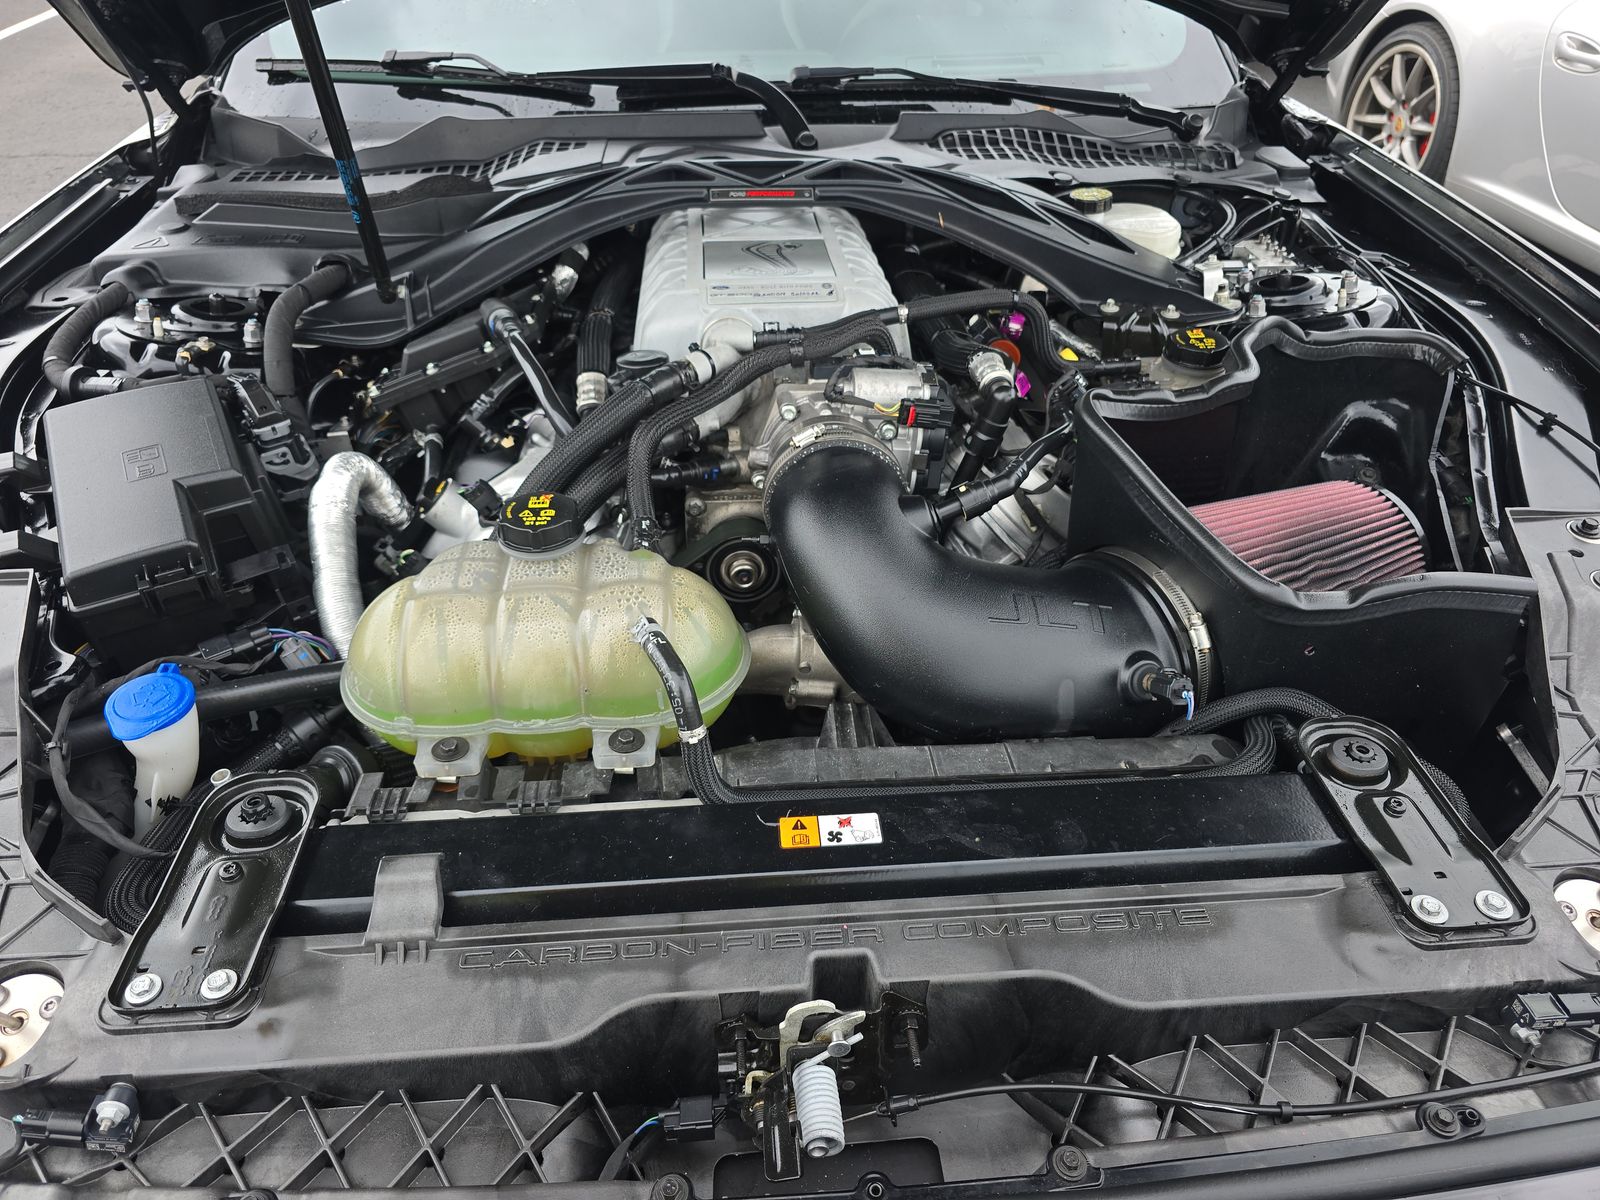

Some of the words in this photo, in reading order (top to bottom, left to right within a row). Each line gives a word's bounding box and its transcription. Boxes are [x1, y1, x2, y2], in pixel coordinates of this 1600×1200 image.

[987, 592, 1113, 636] JLT
[457, 923, 885, 971] CARBON-FIBER
[902, 905, 1214, 943] COMPOSITE
